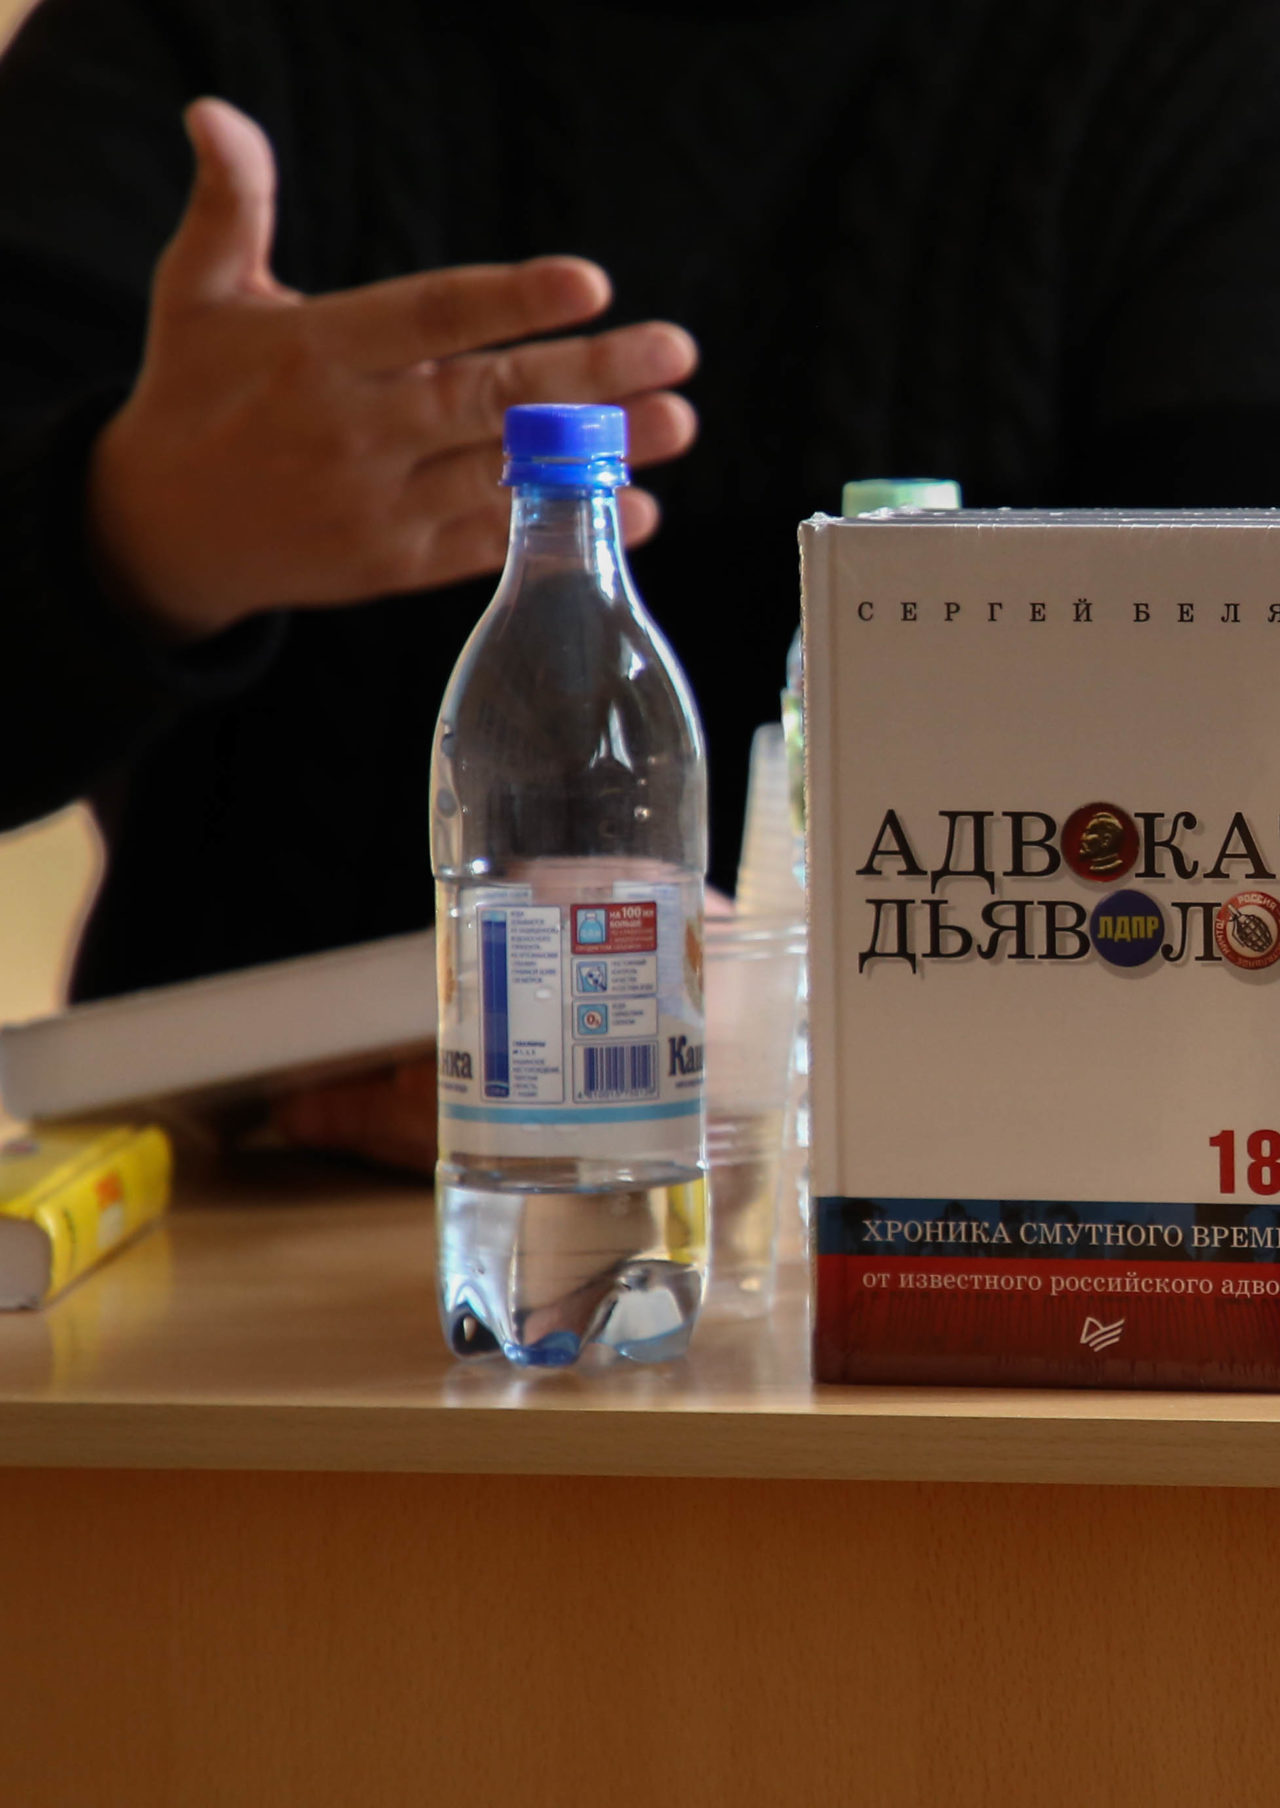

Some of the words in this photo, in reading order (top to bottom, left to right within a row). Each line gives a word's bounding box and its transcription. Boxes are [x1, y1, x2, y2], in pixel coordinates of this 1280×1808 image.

[858, 598, 1093, 622] СЕРГЕЙ
[622, 906, 641, 919] 100
[1097, 914, 1159, 942] ЛДПР
[862, 1219, 1010, 1245] ХРОНИКА
[1019, 1222, 1183, 1248] СМУТНОГО
[862, 1272, 891, 1289] от
[899, 1272, 1043, 1292] известного
[1050, 1270, 1214, 1297] российского
